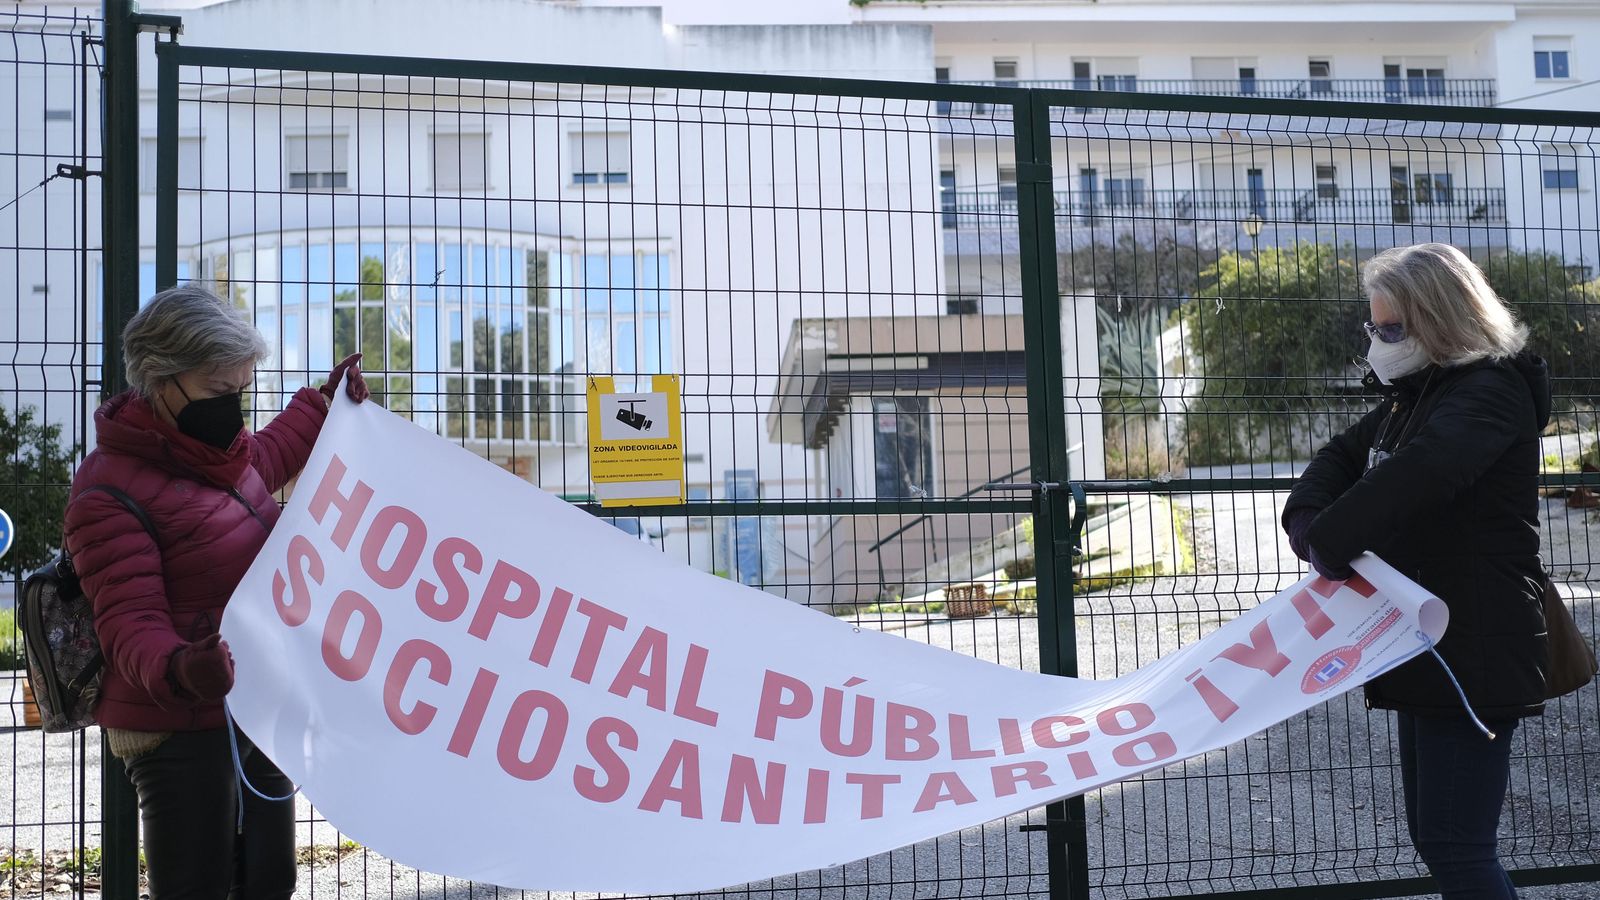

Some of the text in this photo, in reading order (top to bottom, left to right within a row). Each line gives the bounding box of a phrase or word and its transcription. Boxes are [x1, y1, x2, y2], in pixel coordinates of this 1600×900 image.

[272, 534, 1178, 825] SOCIOSANITARIO
[307, 453, 1156, 761] HOSPITAL PÚBLICO
